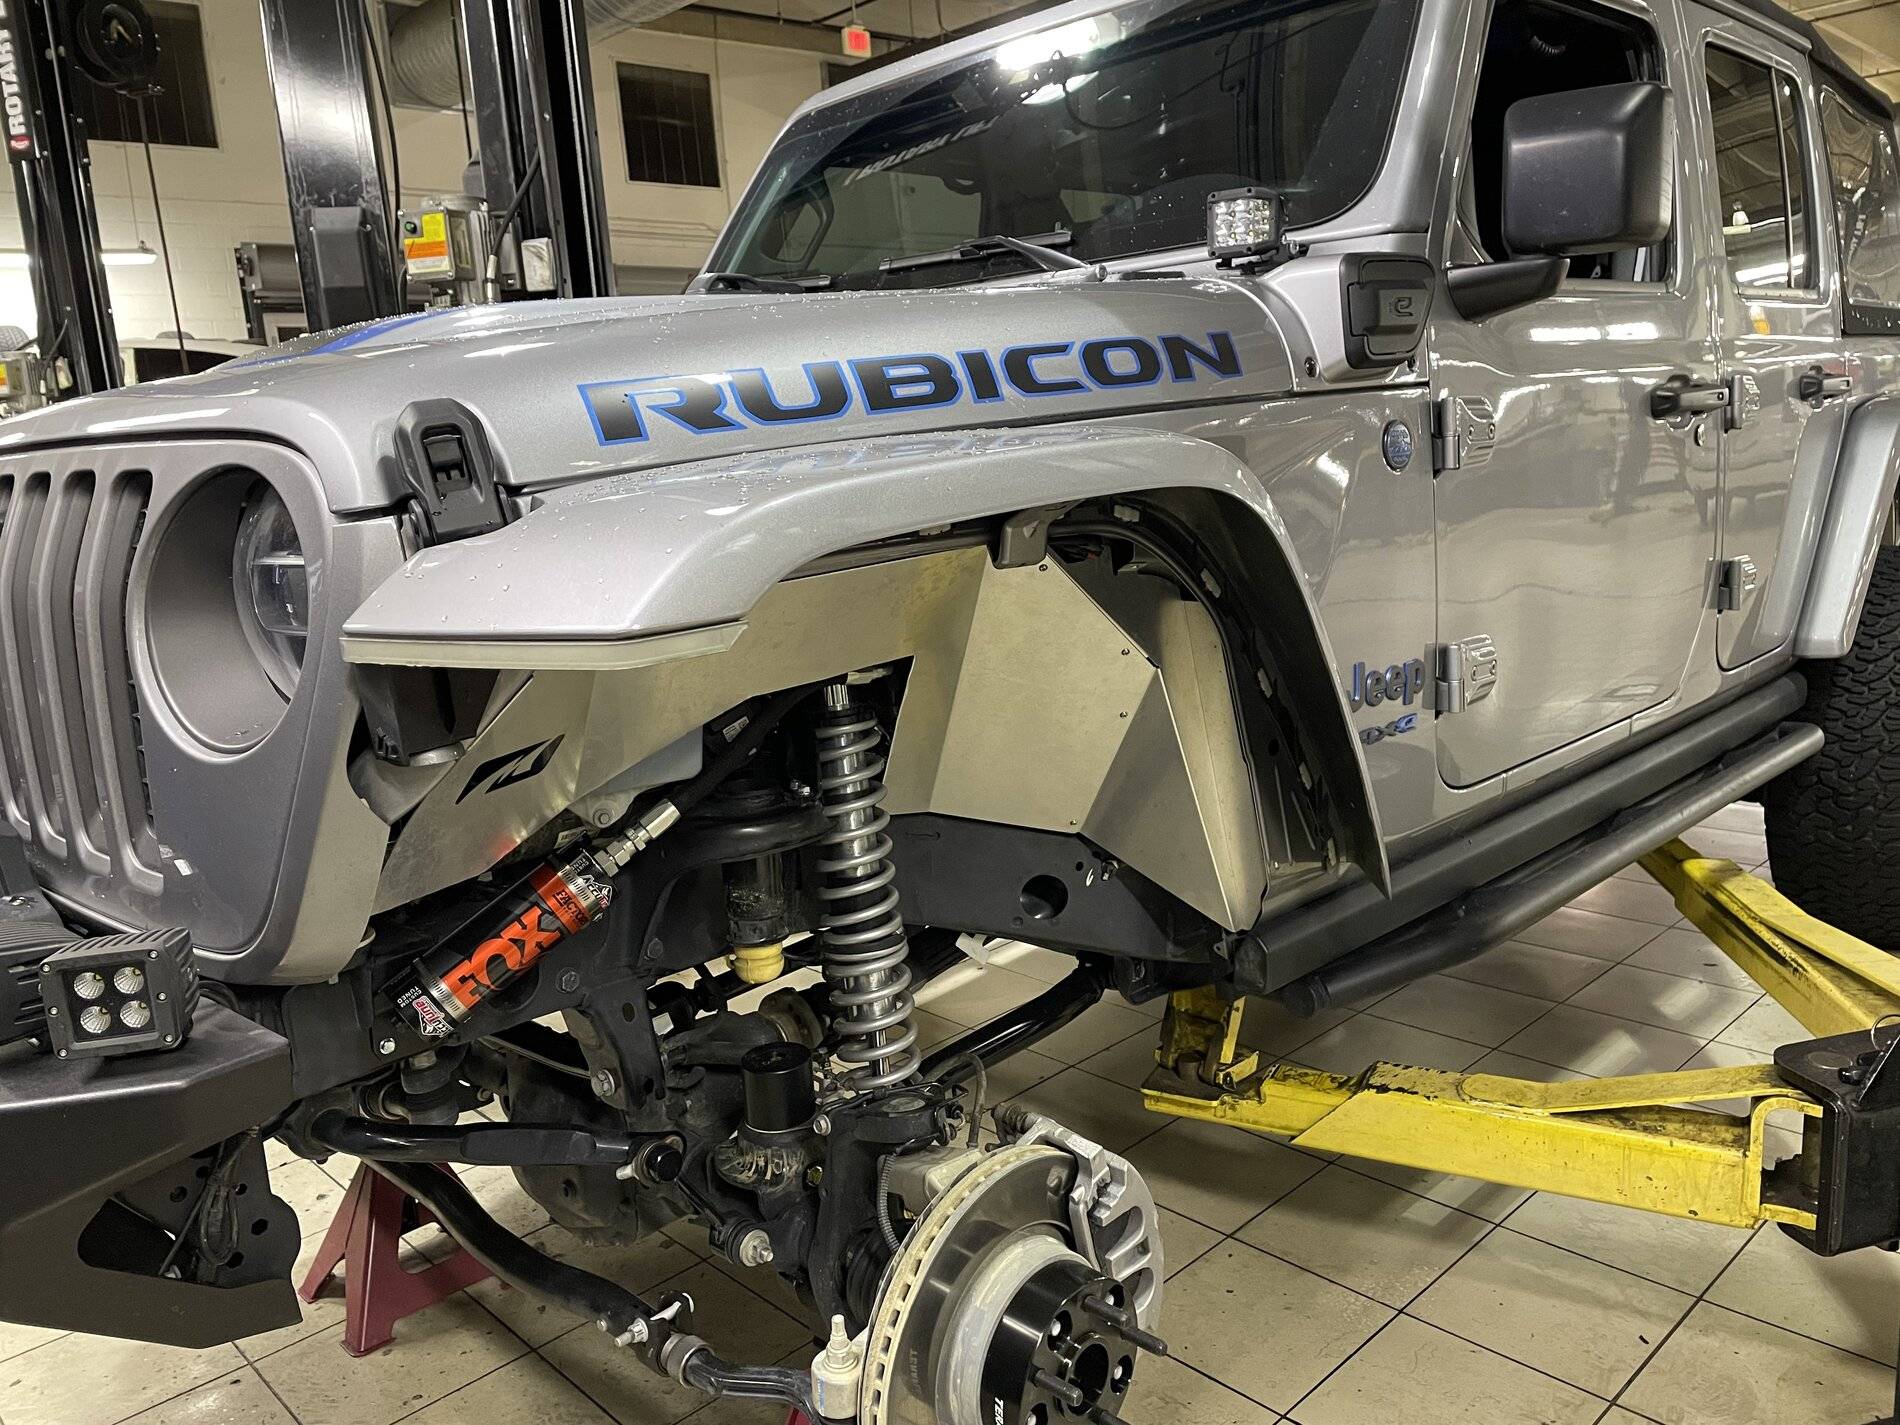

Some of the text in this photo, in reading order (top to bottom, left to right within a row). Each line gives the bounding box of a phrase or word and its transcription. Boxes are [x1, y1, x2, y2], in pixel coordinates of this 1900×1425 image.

[577, 331, 1243, 446] RUBICON
[1346, 658, 1425, 713] Jeep
[397, 985, 419, 1004] TUNED
[443, 904, 561, 1010] FOX
